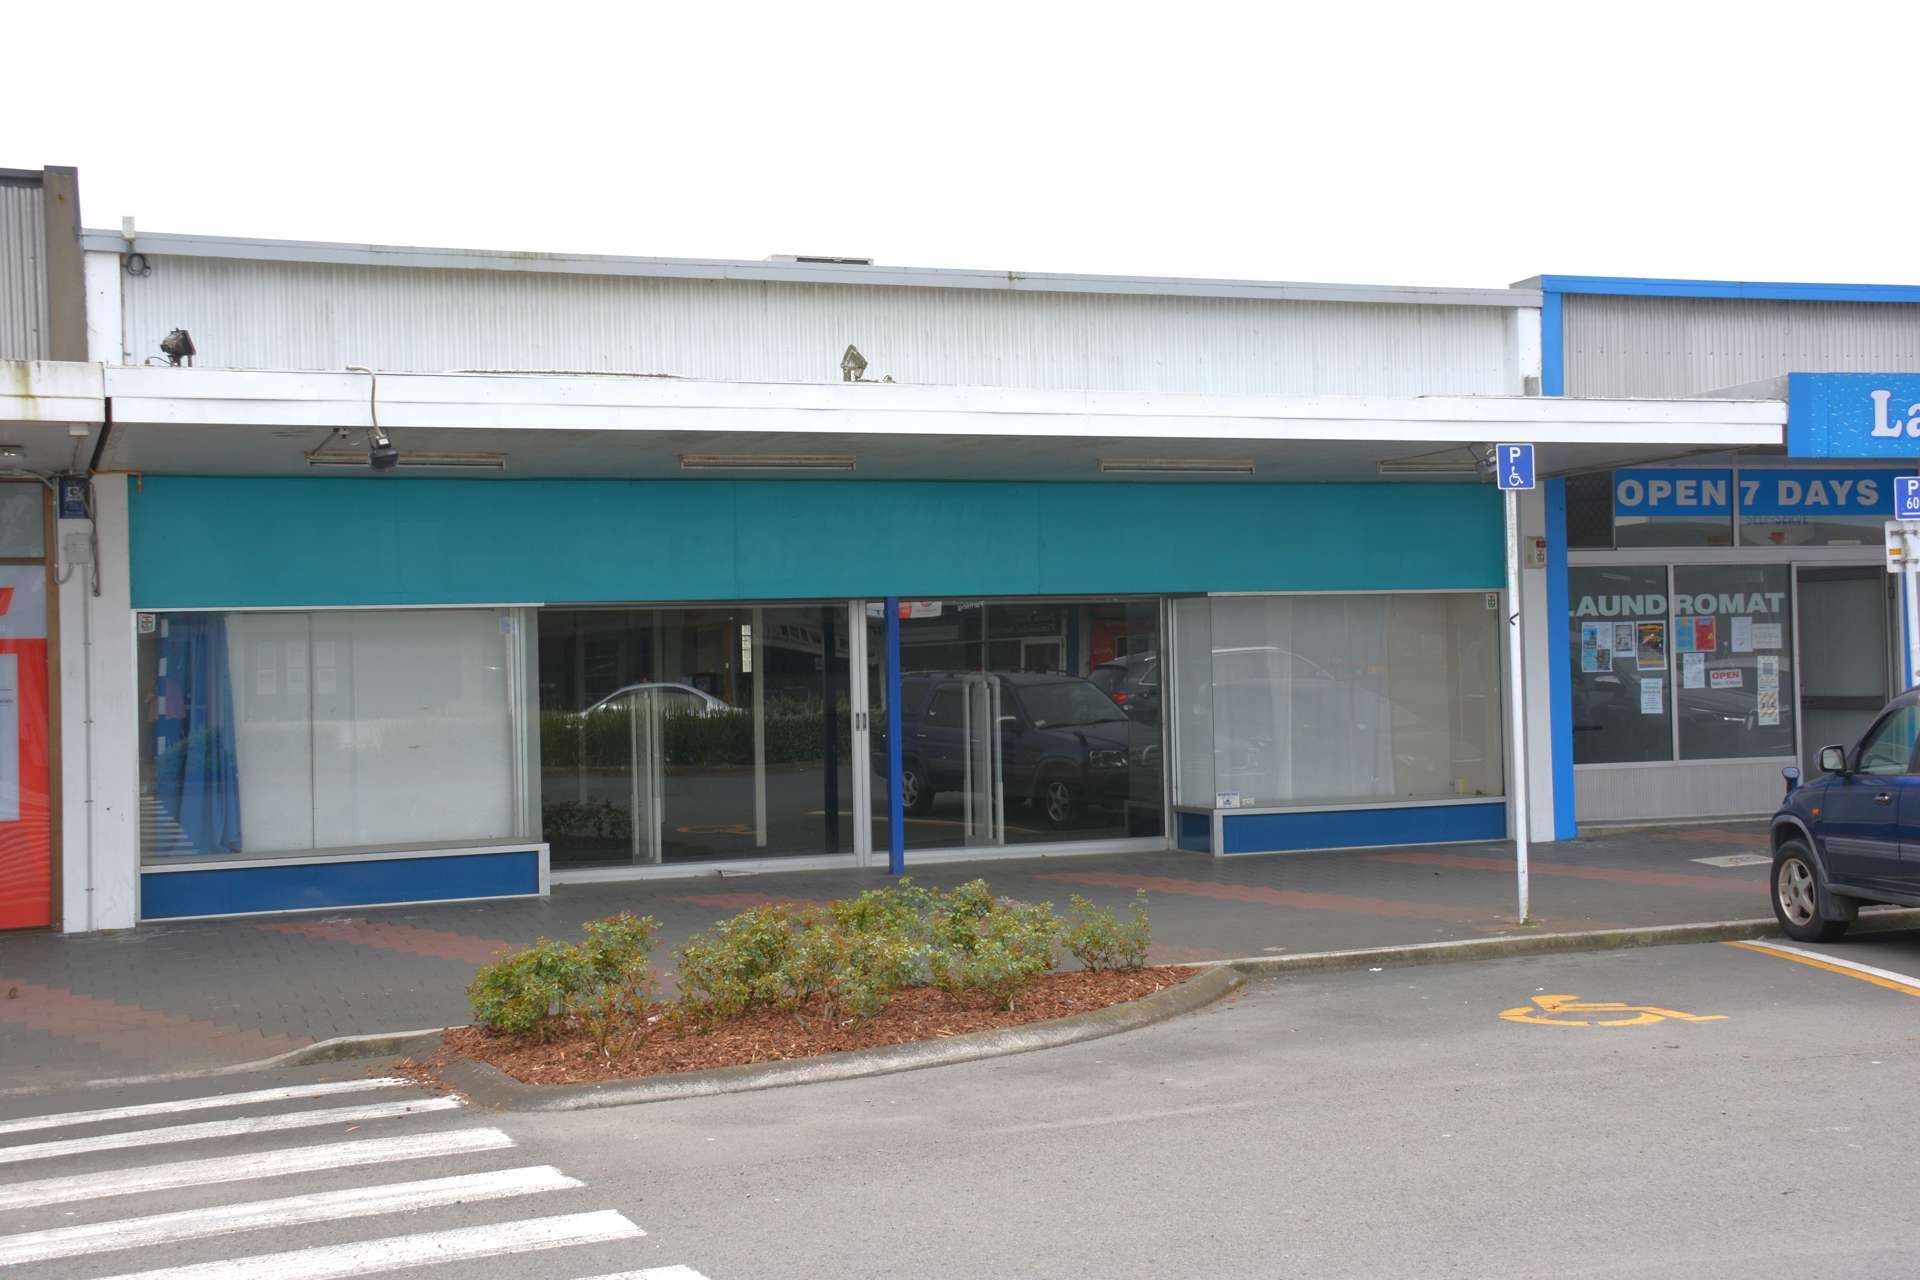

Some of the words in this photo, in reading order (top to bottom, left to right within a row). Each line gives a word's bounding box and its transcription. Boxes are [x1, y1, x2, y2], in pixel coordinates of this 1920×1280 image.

[1509, 446, 1521, 463] P
[1616, 479, 1727, 507] OPEN
[1739, 480, 1761, 506] 7
[1777, 479, 1880, 507] DAYS
[1907, 479, 1919, 496] P
[1906, 496, 1920, 510] 60
[1568, 592, 1785, 617] AUNDROMAT
